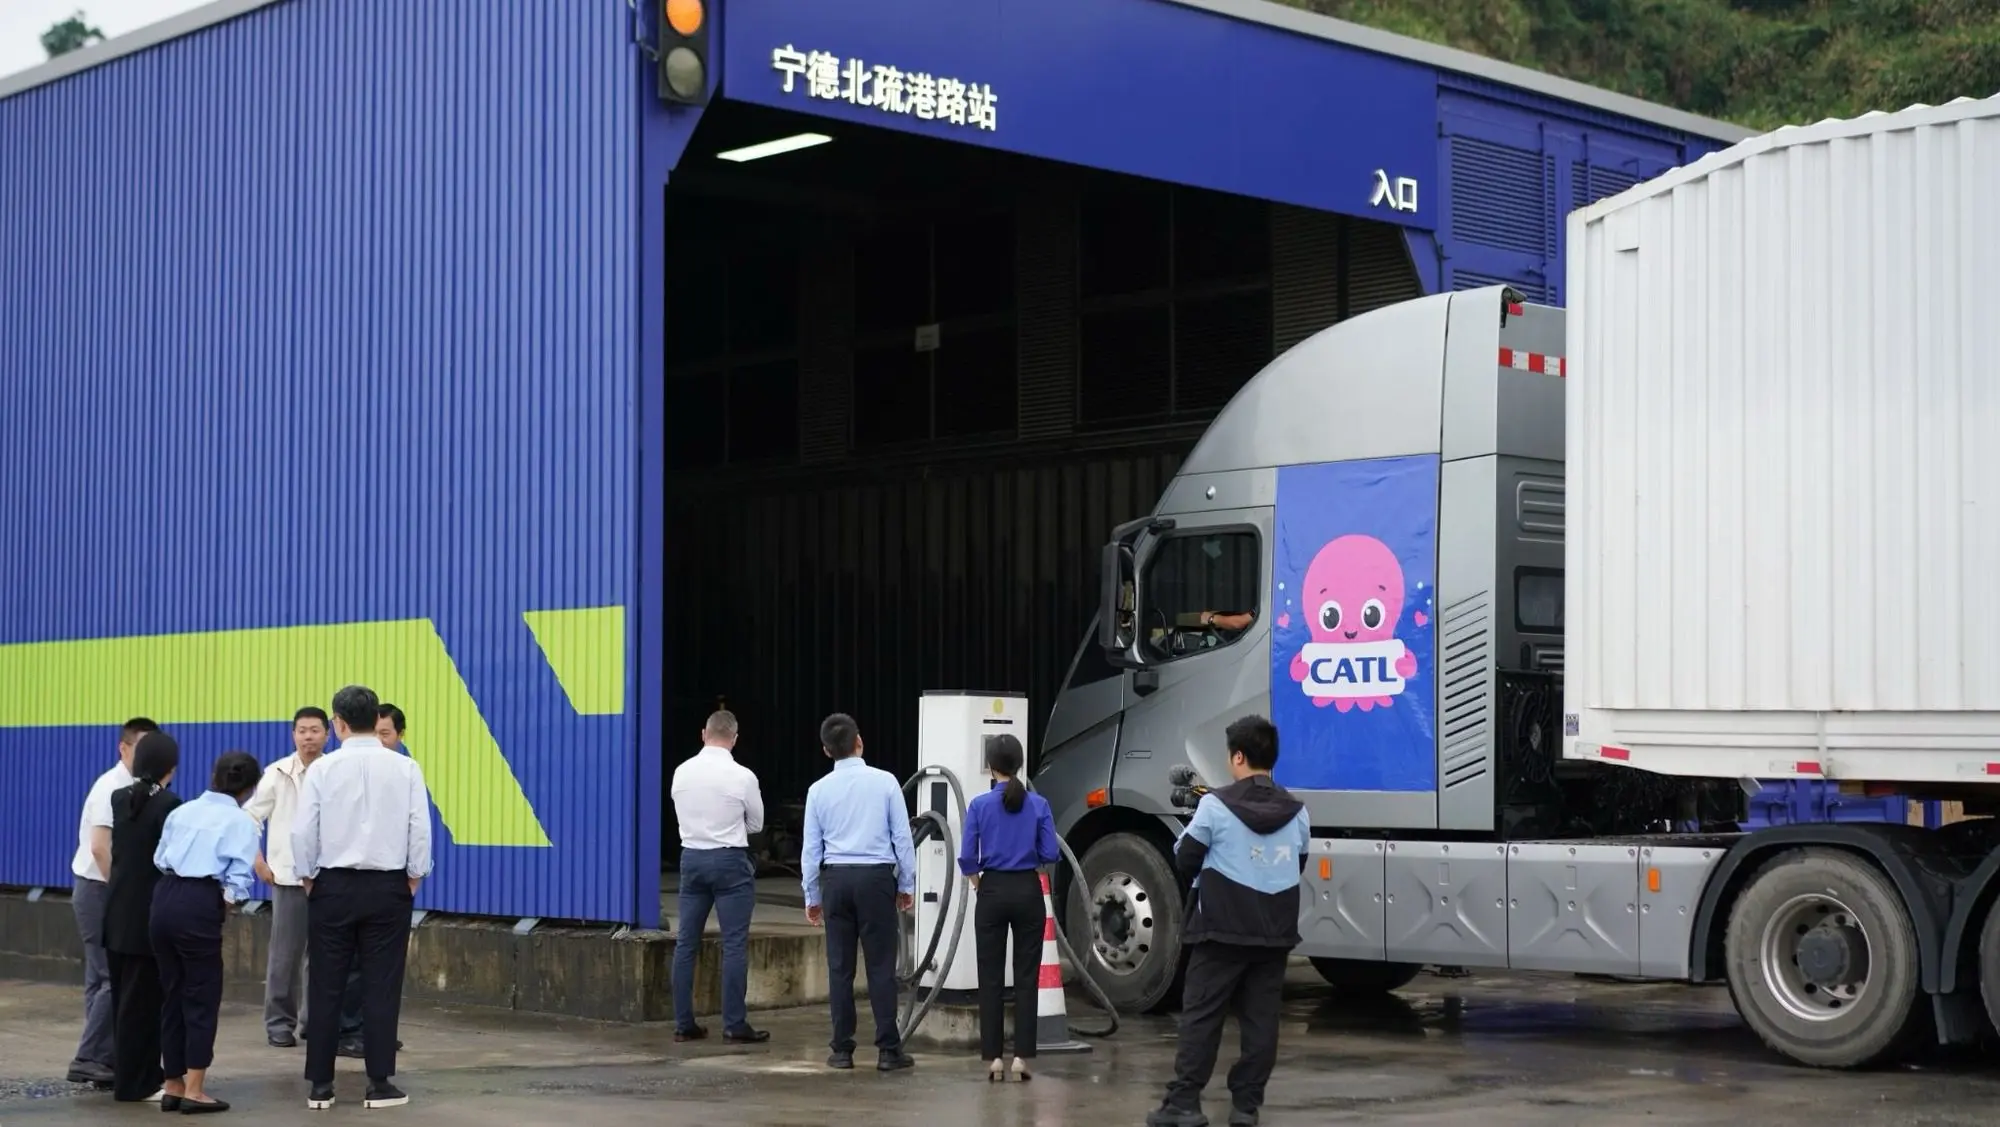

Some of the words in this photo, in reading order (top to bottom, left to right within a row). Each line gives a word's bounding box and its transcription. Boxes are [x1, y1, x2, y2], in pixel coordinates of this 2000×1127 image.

[772, 43, 998, 131] 宁德北疏港路站
[1370, 168, 1418, 213] 入口
[1310, 656, 1398, 684] CATL
